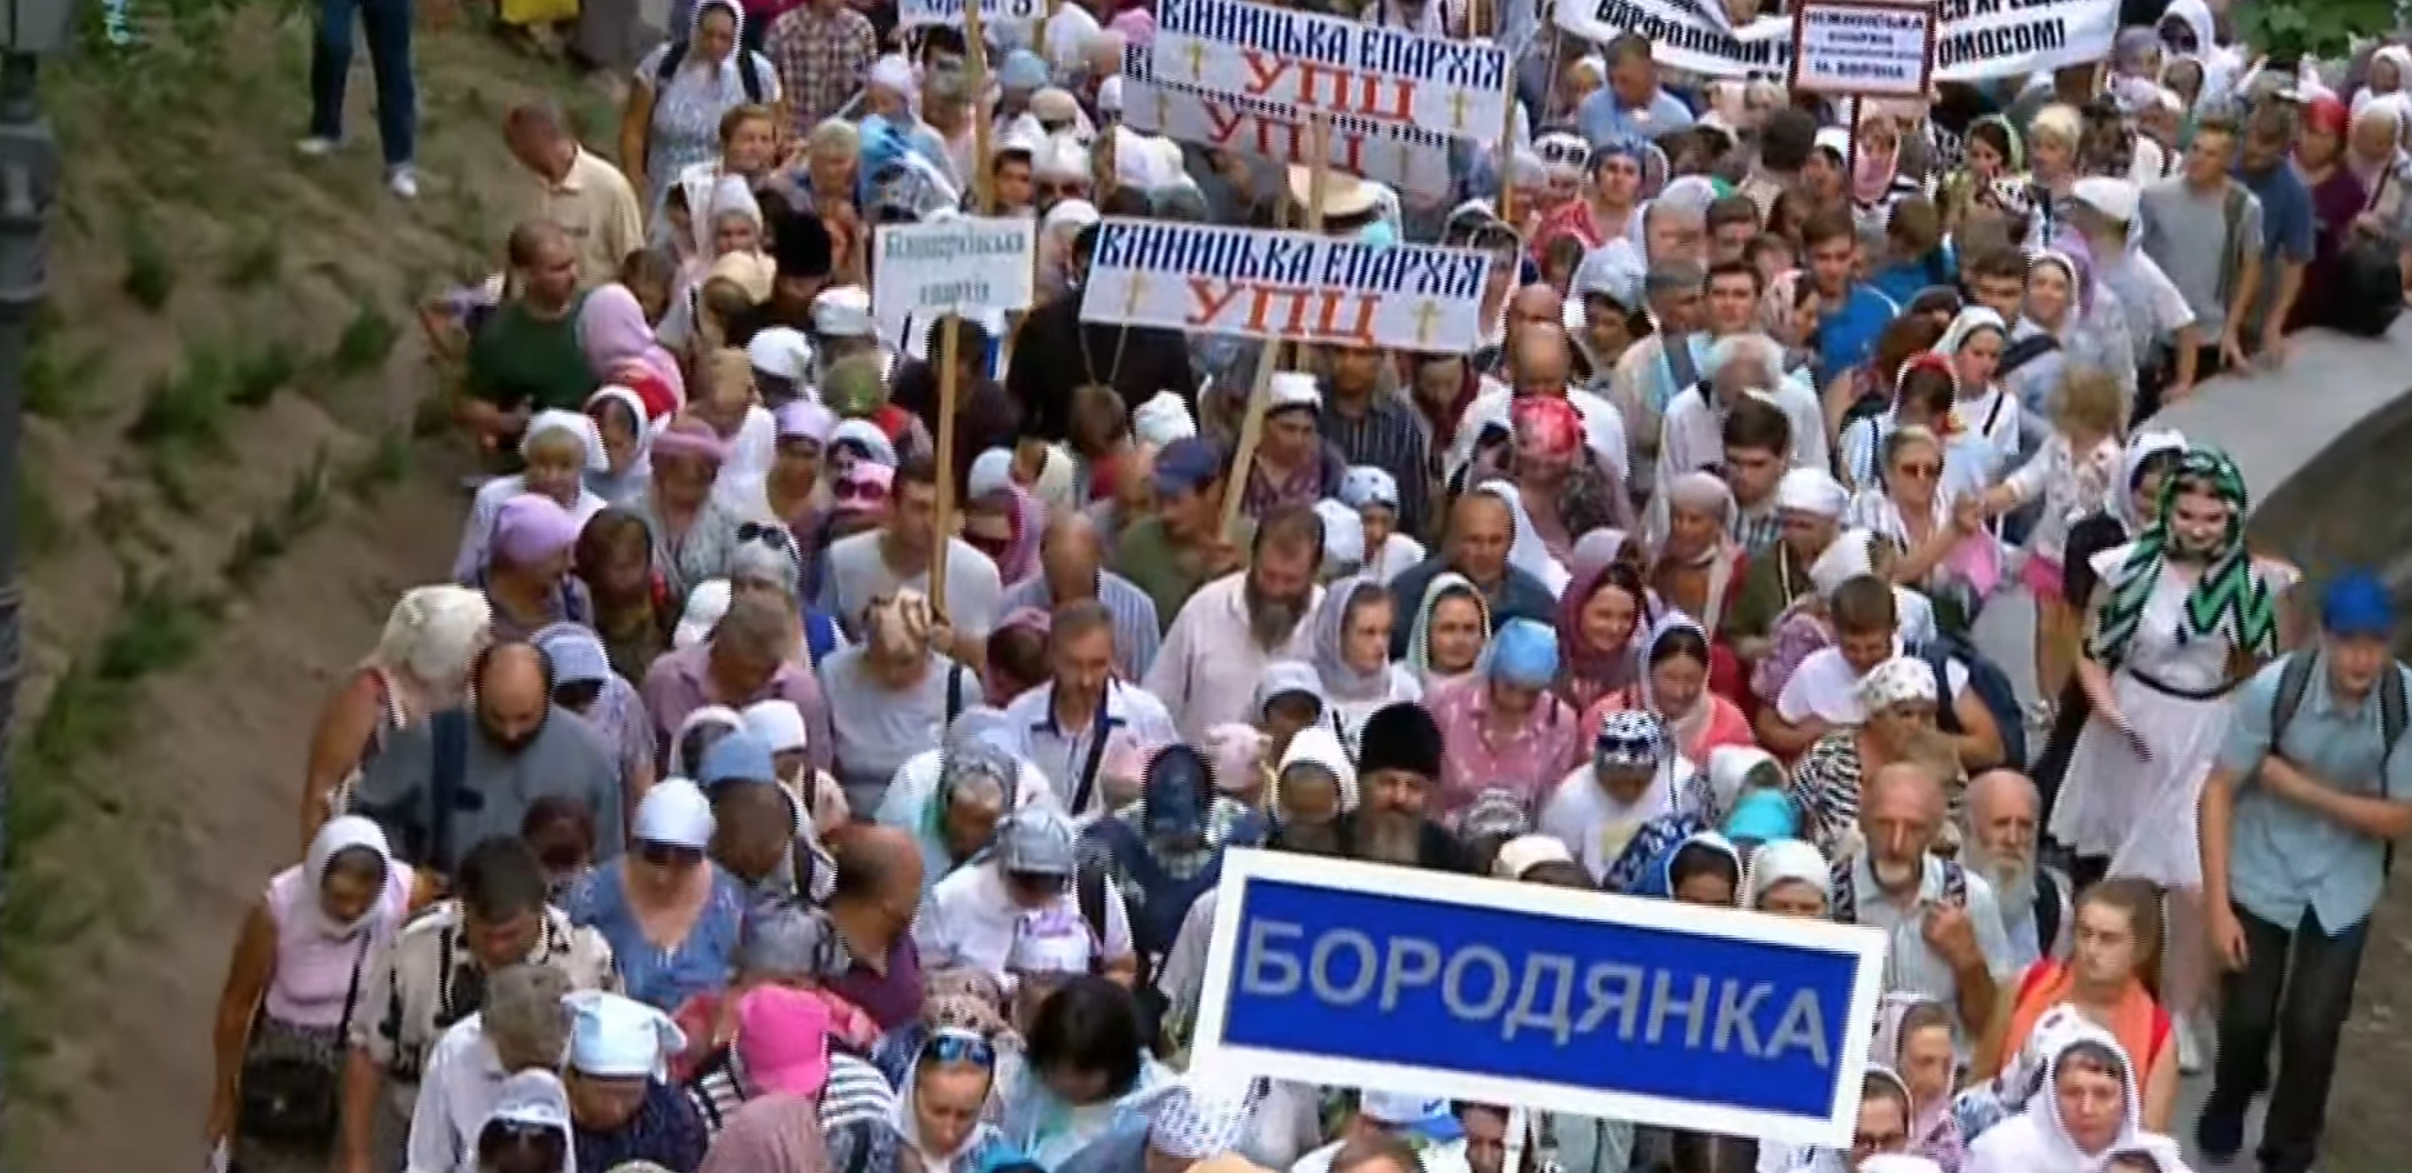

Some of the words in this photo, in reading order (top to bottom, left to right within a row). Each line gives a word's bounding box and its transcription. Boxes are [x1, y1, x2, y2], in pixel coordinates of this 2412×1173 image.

[1241, 48, 1418, 124] УПЦ
[1184, 271, 1383, 346] УПЦ
[1240, 916, 1831, 1069] БОРОДЯНКА
